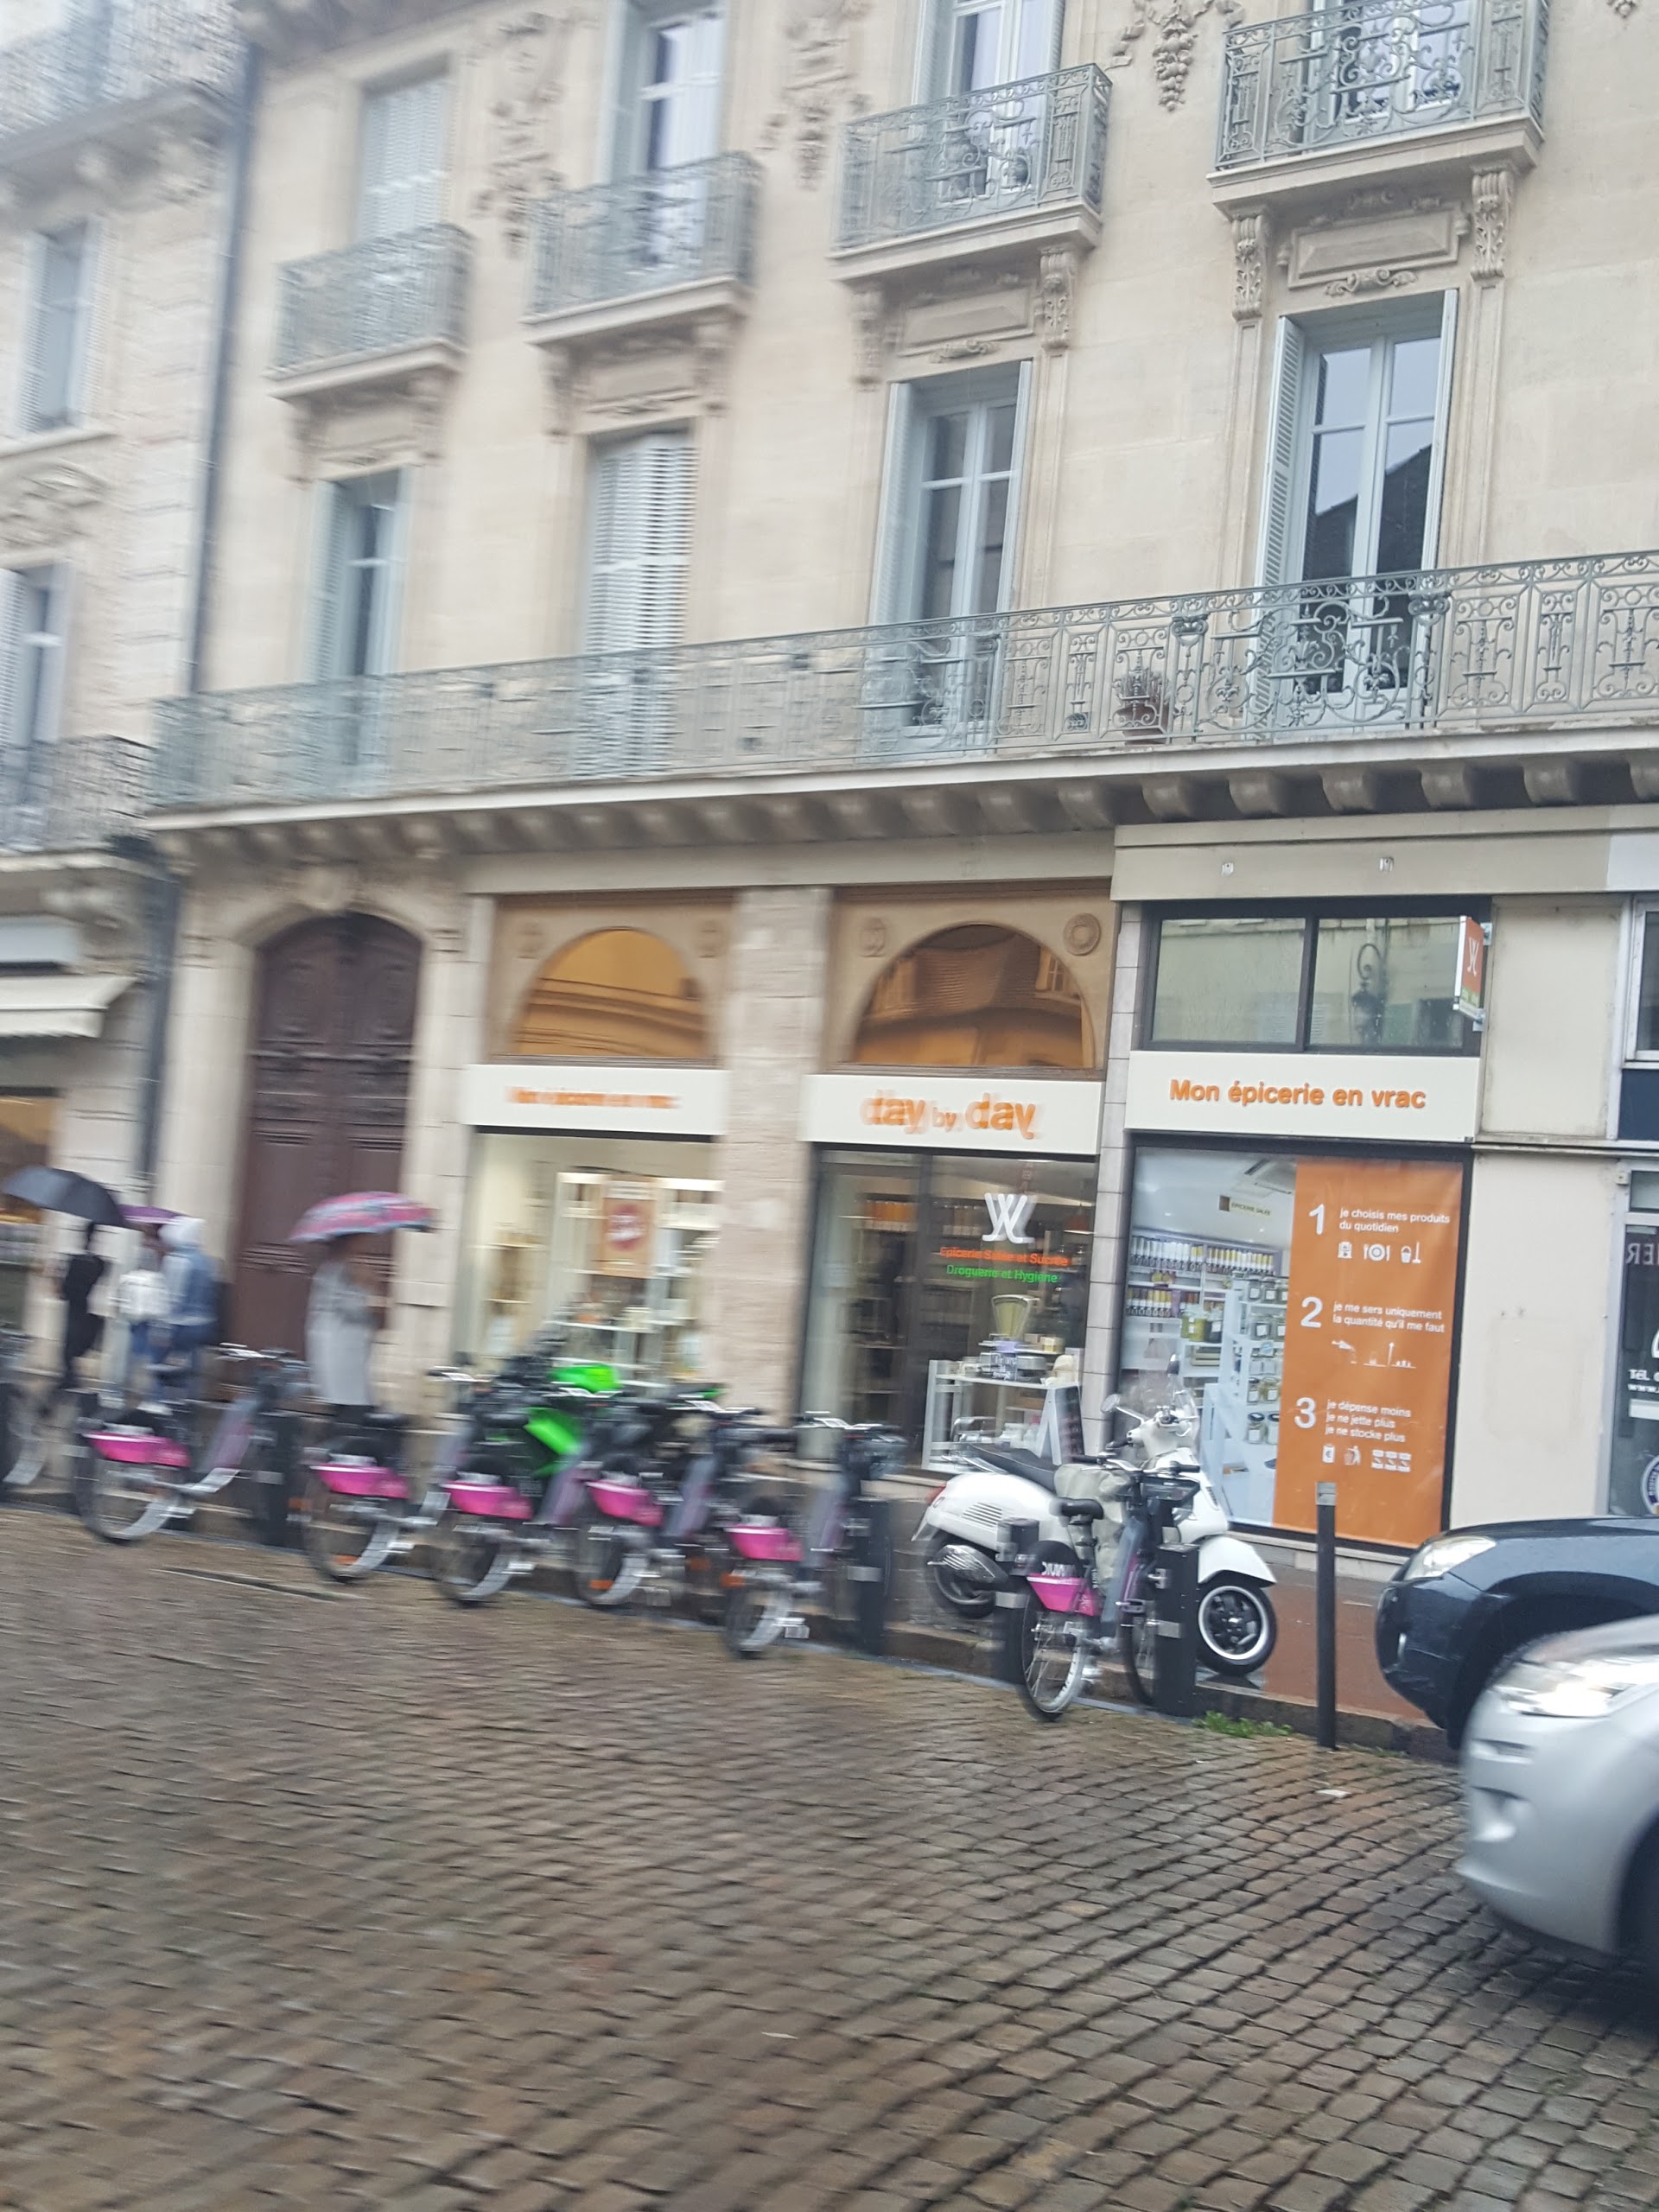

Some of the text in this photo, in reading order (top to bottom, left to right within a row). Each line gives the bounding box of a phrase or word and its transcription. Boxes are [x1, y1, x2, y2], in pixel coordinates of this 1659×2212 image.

[1170, 1079, 1426, 1109] Mon épicerie en vrac
[860, 1090, 1036, 1140] day by day
[1309, 1204, 1325, 1235] 1
[1340, 1207, 1350, 1218] je
[1351, 1209, 1384, 1220] choisis
[1409, 1213, 1450, 1224] produits
[1339, 1221, 1399, 1234] du quotidien
[1300, 1296, 1323, 1328] 2
[1333, 1301, 1442, 1319] je me sers uniquement
[1332, 1313, 1342, 1324] la
[1407, 1322, 1422, 1331] me
[1425, 1323, 1445, 1333] faut
[1294, 1397, 1316, 1428] 3
[1326, 1399, 1337, 1411] je
[1337, 1414, 1349, 1423] ne
[1336, 1427, 1348, 1436] ne
